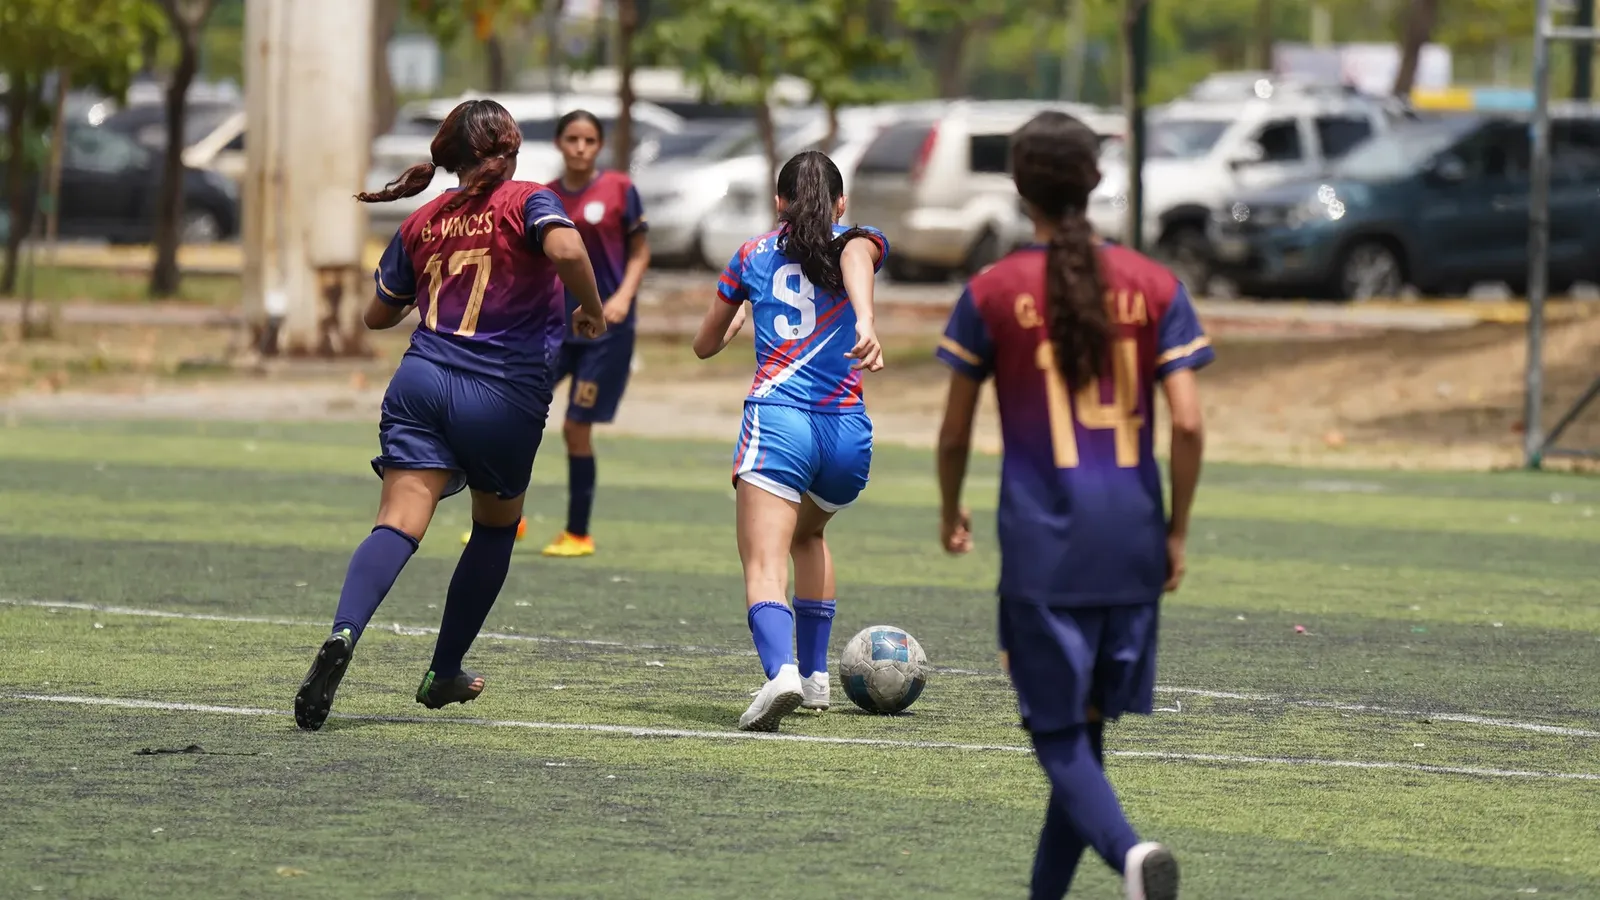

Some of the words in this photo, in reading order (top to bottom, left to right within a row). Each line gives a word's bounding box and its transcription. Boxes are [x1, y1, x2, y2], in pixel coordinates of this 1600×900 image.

[756, 238, 768, 254] S.
[423, 247, 492, 336] 17
[1014, 292, 1044, 330] G.
[574, 379, 599, 408] 19
[1035, 338, 1144, 468] 14
